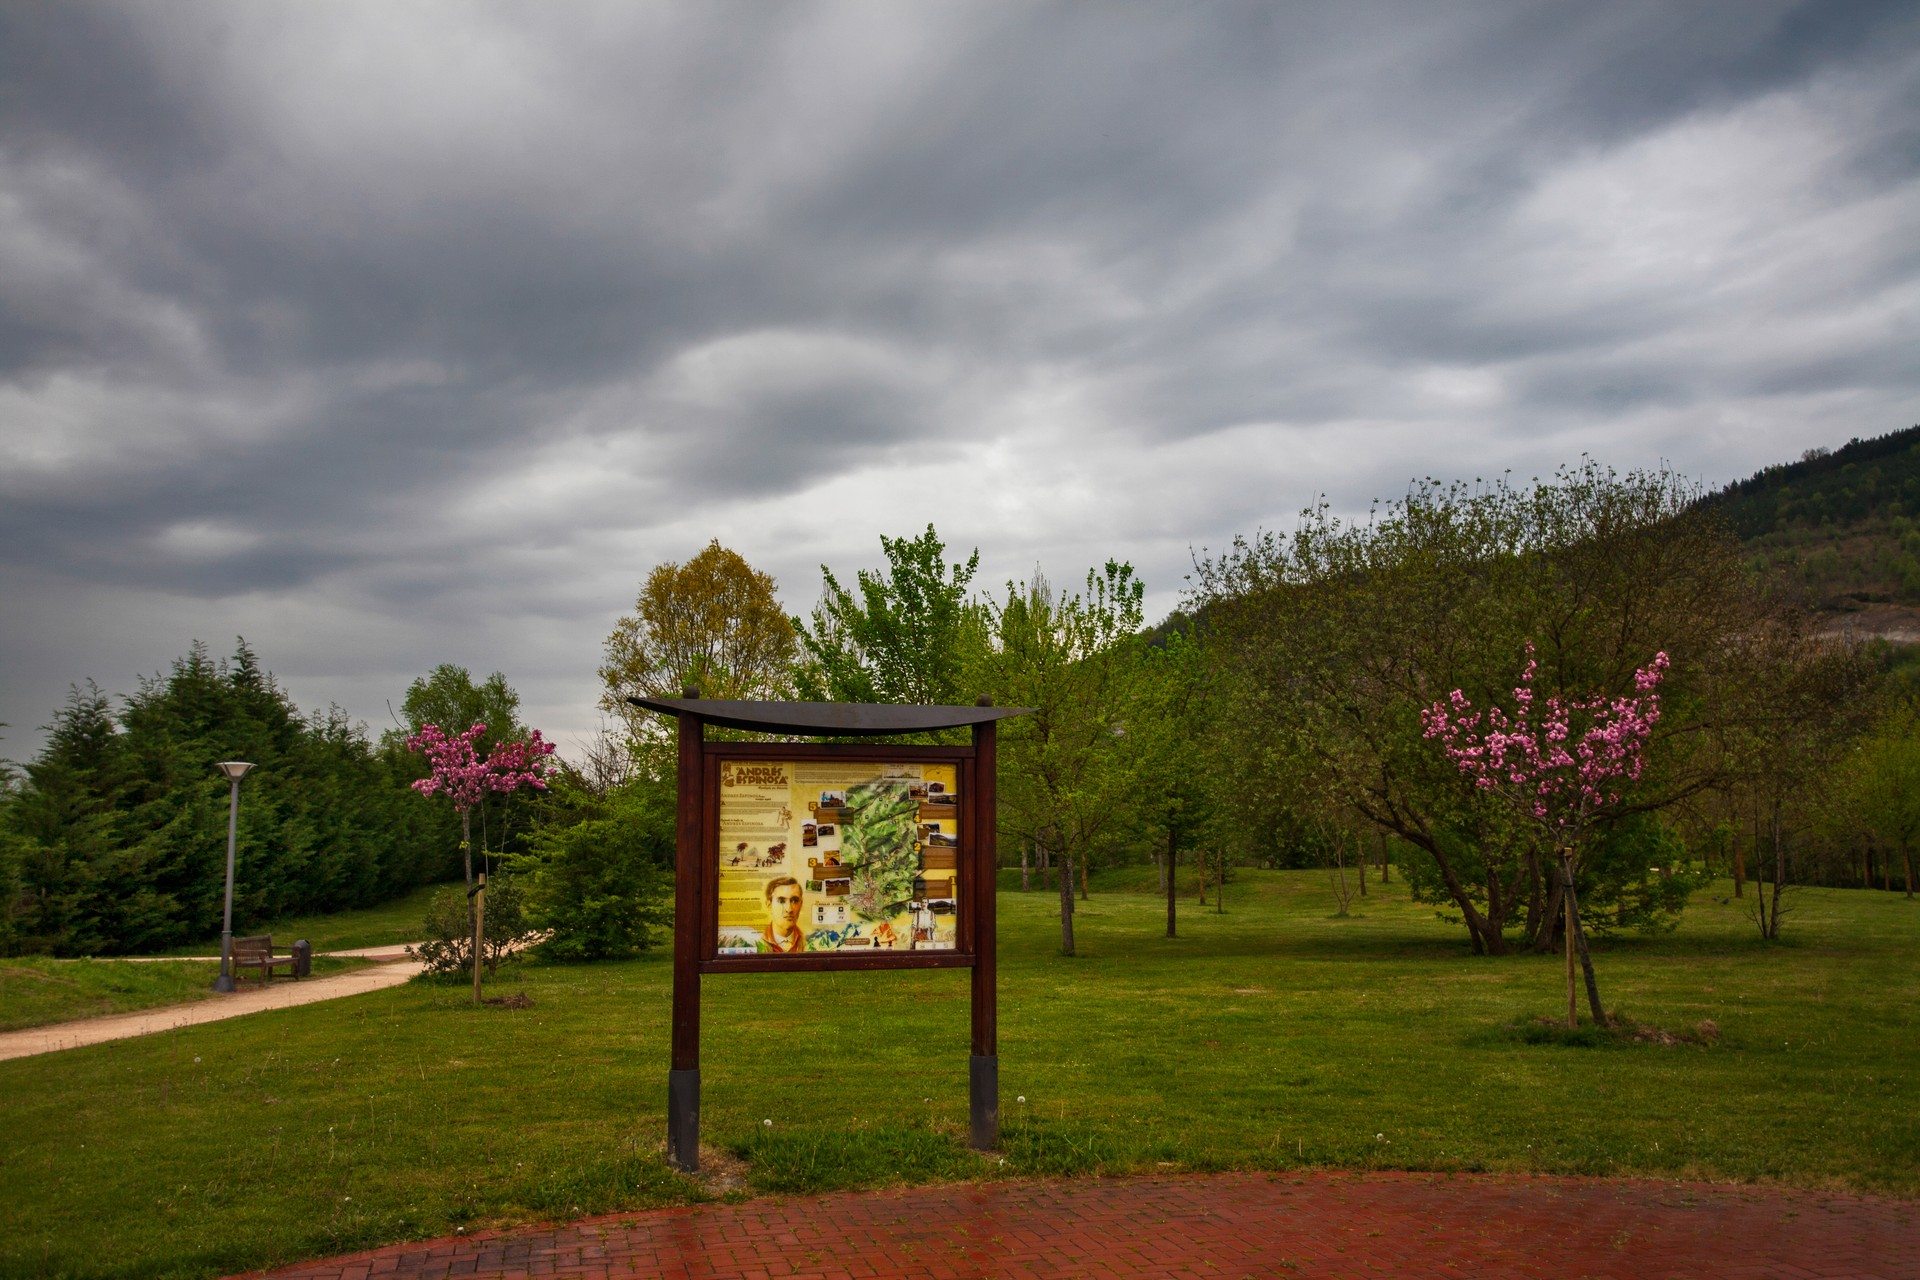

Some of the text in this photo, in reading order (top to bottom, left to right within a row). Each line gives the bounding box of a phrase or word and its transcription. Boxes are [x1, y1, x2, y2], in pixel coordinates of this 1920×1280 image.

[810, 802, 817, 810] 5
[914, 842, 921, 850] 2
[810, 858, 817, 866] 3
[949, 877, 956, 885] 1
